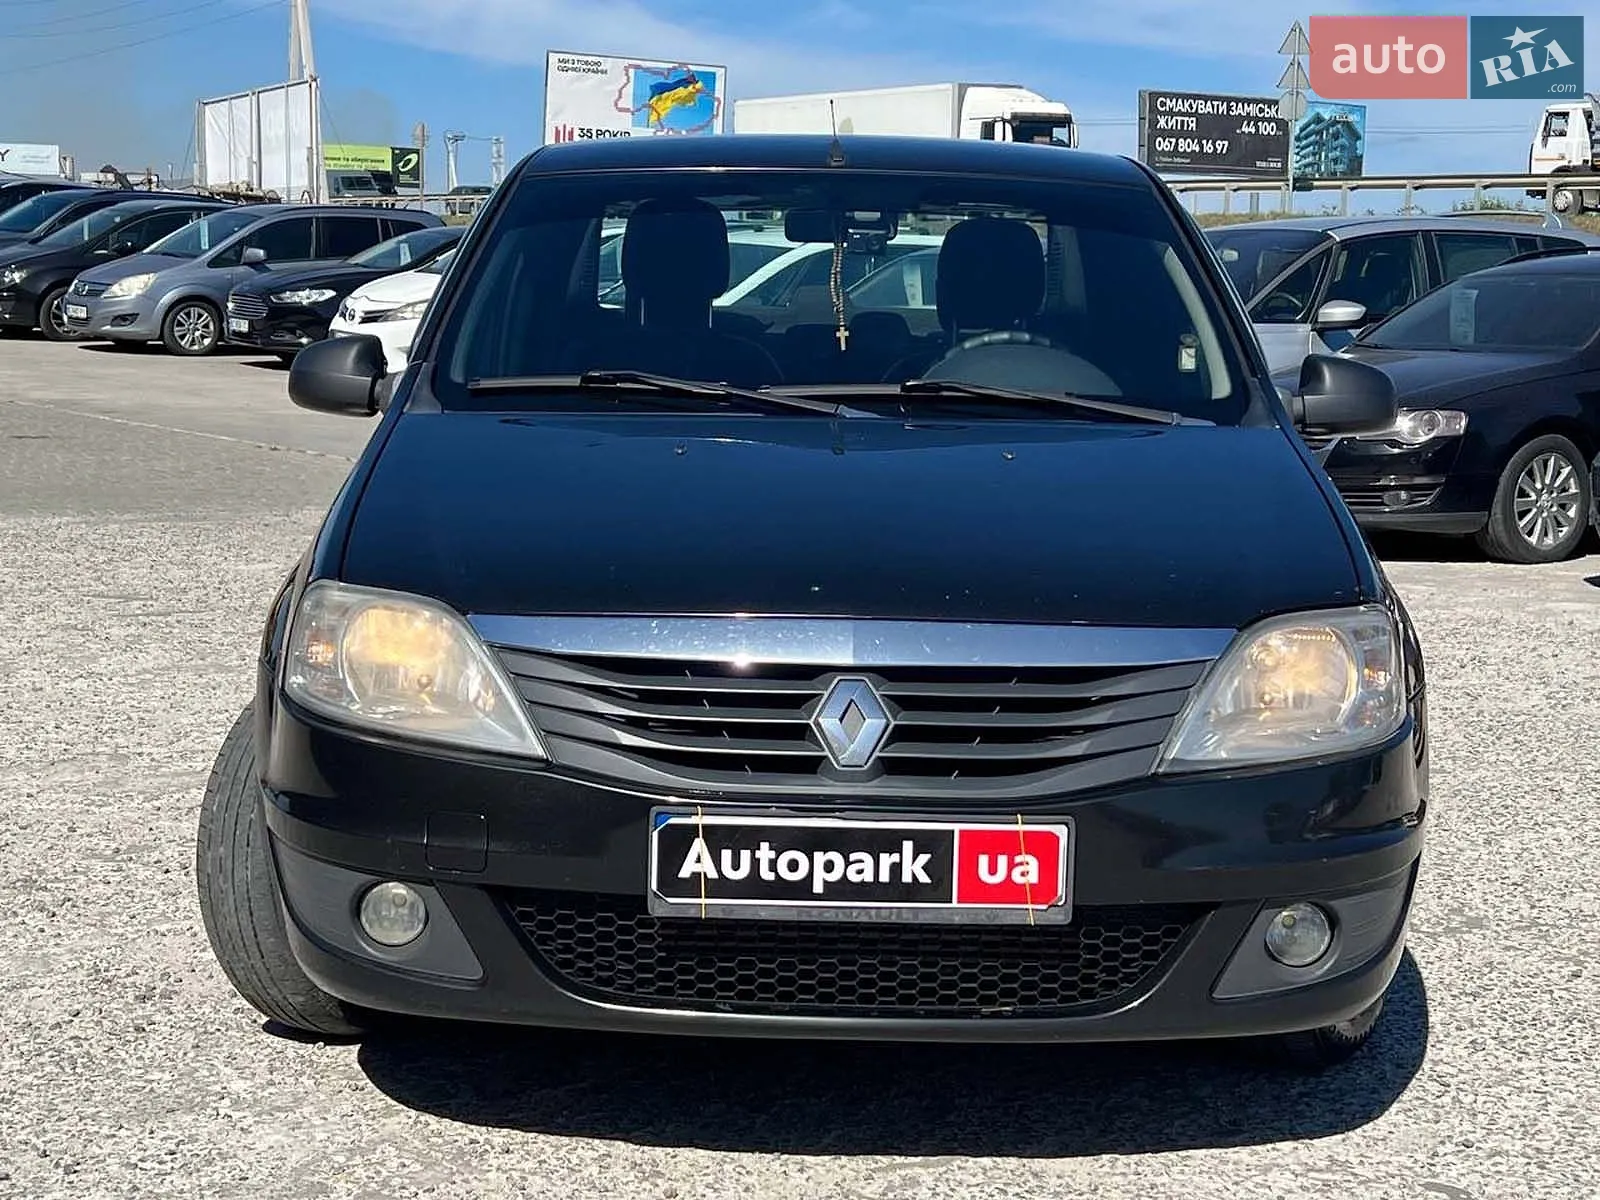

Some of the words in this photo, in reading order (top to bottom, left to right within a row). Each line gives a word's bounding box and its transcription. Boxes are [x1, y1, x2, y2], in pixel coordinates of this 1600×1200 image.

[1156, 97, 1227, 115] СМАКУВАТИ
[1156, 115, 1197, 131] ЖИТТЯ
[1241, 120, 1256, 135] 44
[1257, 121, 1277, 136] 100
[578, 127, 593, 139] 35
[1155, 137, 1176, 152] 067
[1178, 138, 1200, 153] 804
[1201, 139, 1214, 154] 16
[1215, 140, 1229, 155] 97
[677, 837, 932, 894] Autopark
[977, 853, 1041, 885] ua
